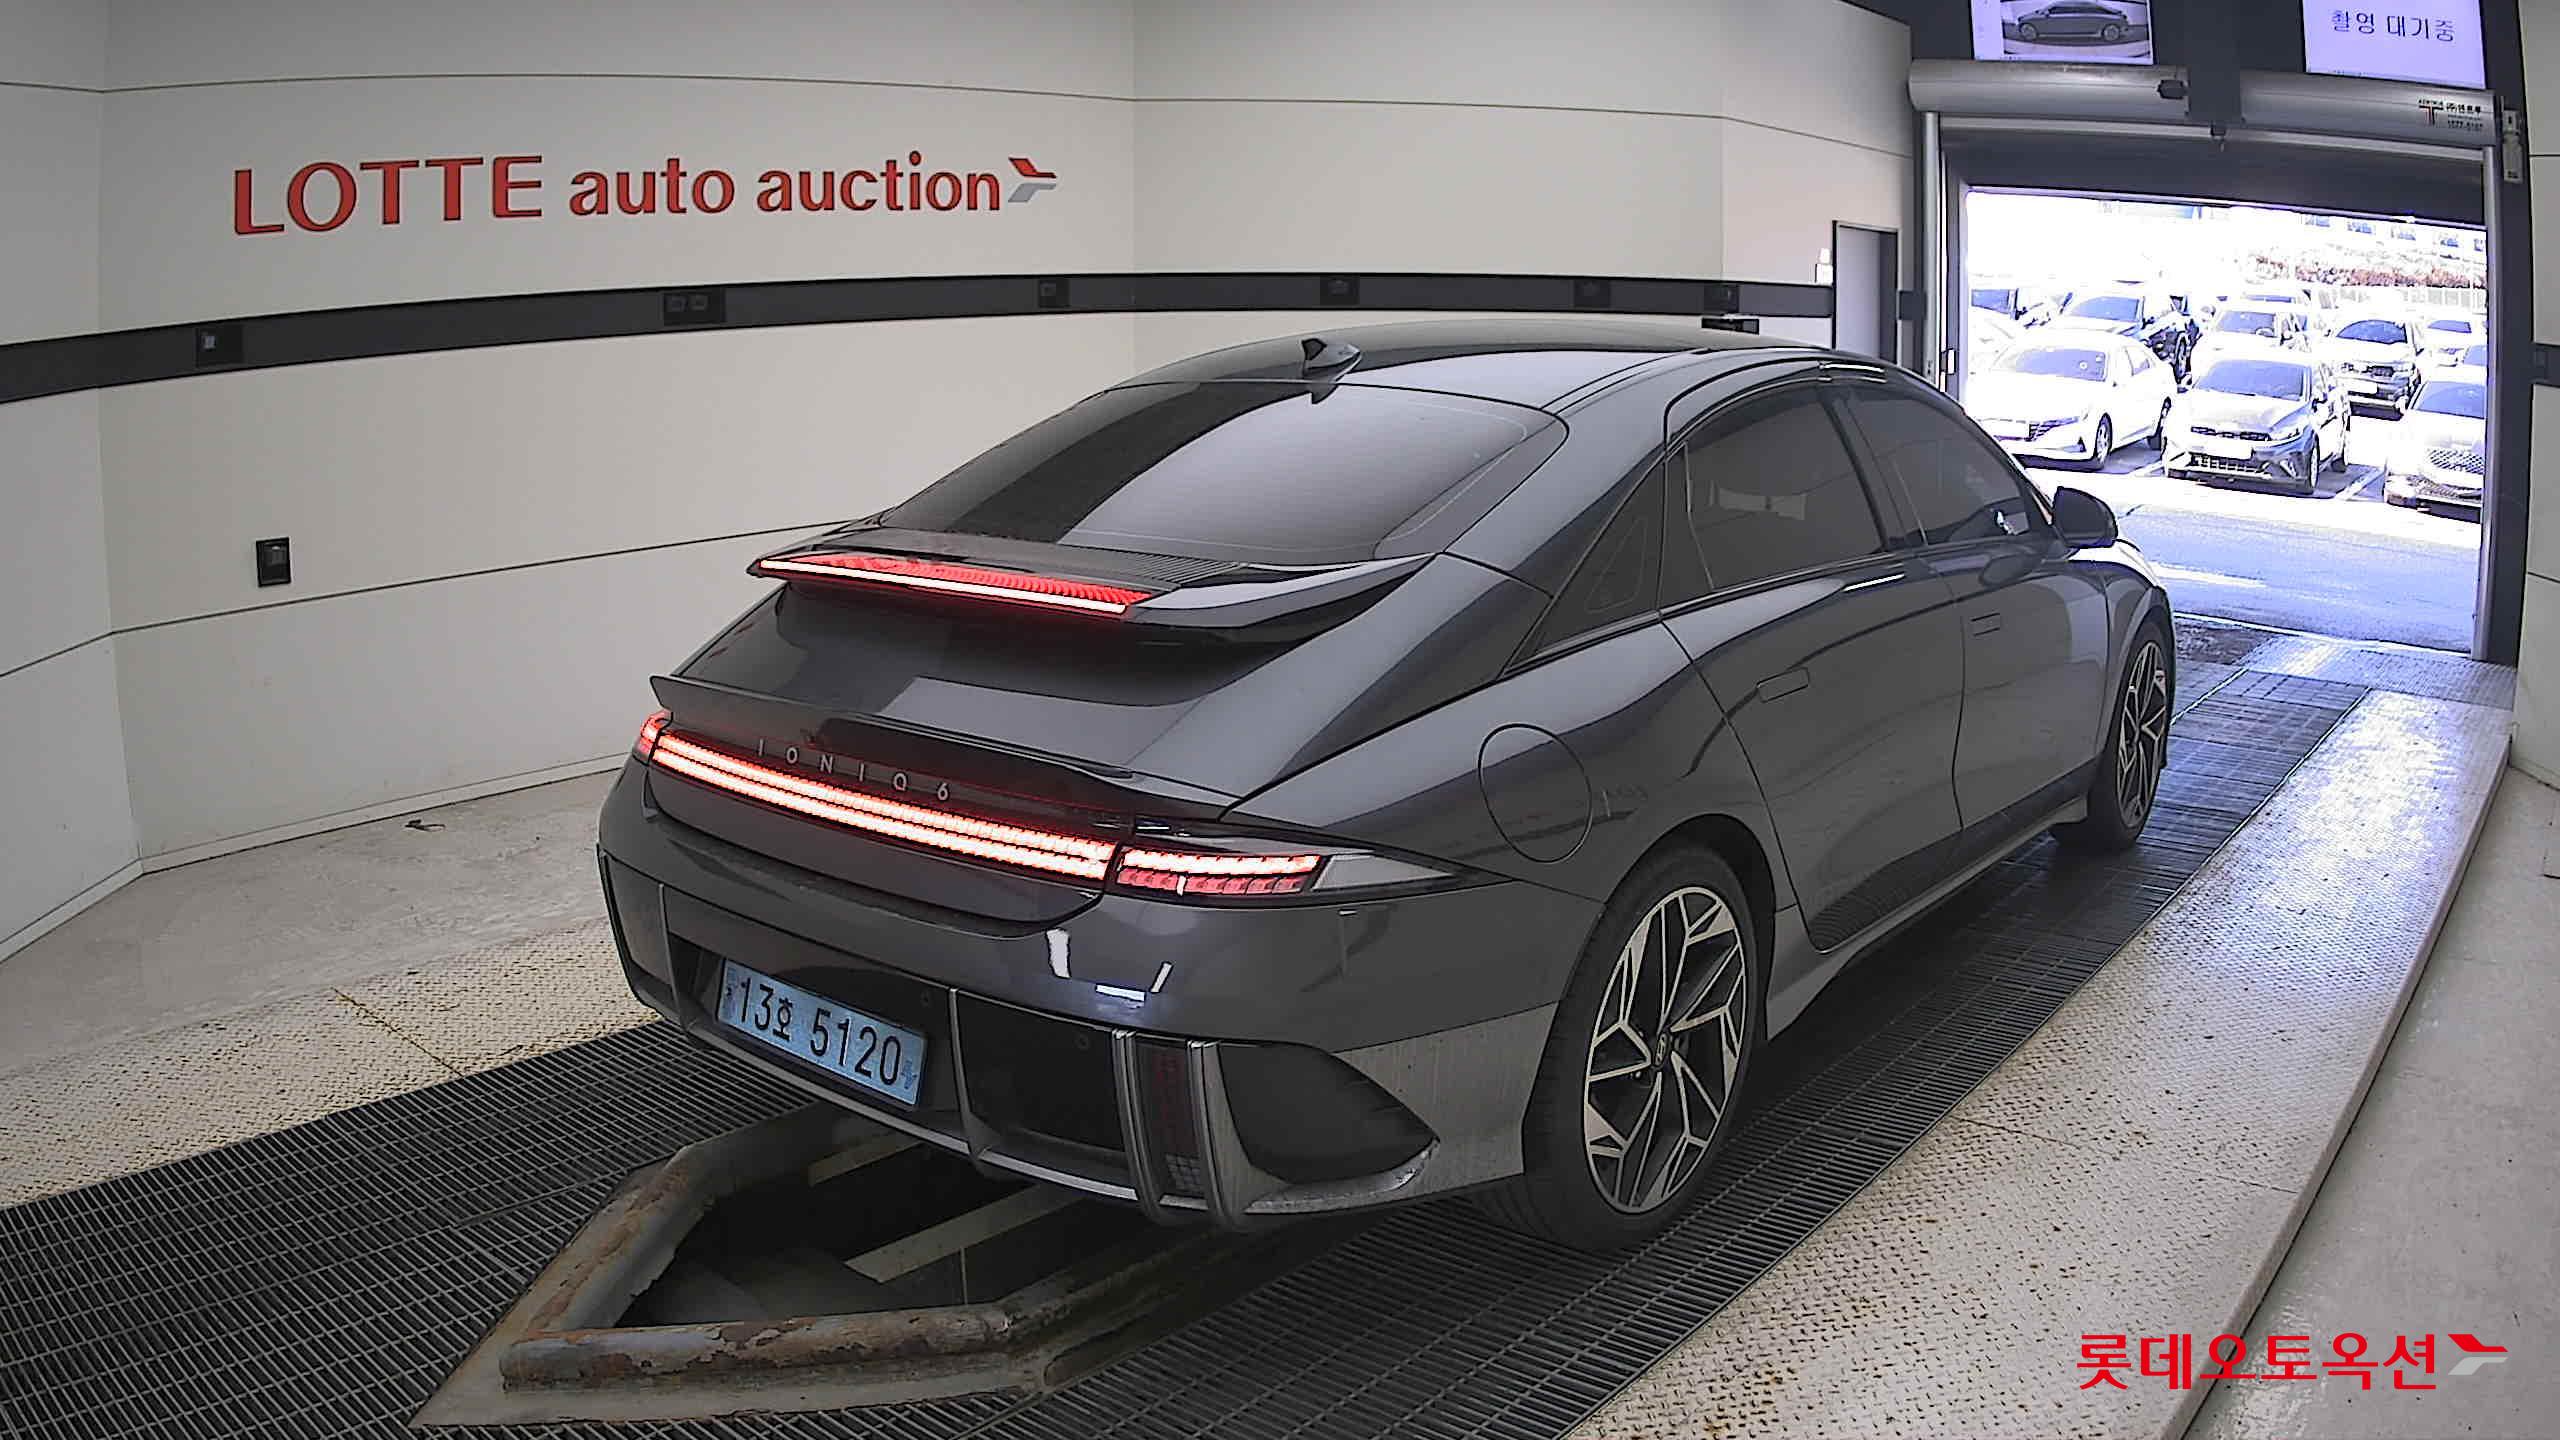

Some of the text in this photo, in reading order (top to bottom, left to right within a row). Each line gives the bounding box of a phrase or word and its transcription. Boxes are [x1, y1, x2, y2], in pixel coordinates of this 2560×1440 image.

[2331, 10, 2454, 42] 촬영 대기중
[234, 150, 1001, 235] LOTTE auto auction
[757, 738, 950, 801] IONIQ 6
[740, 978, 902, 1085] 13호 5120
